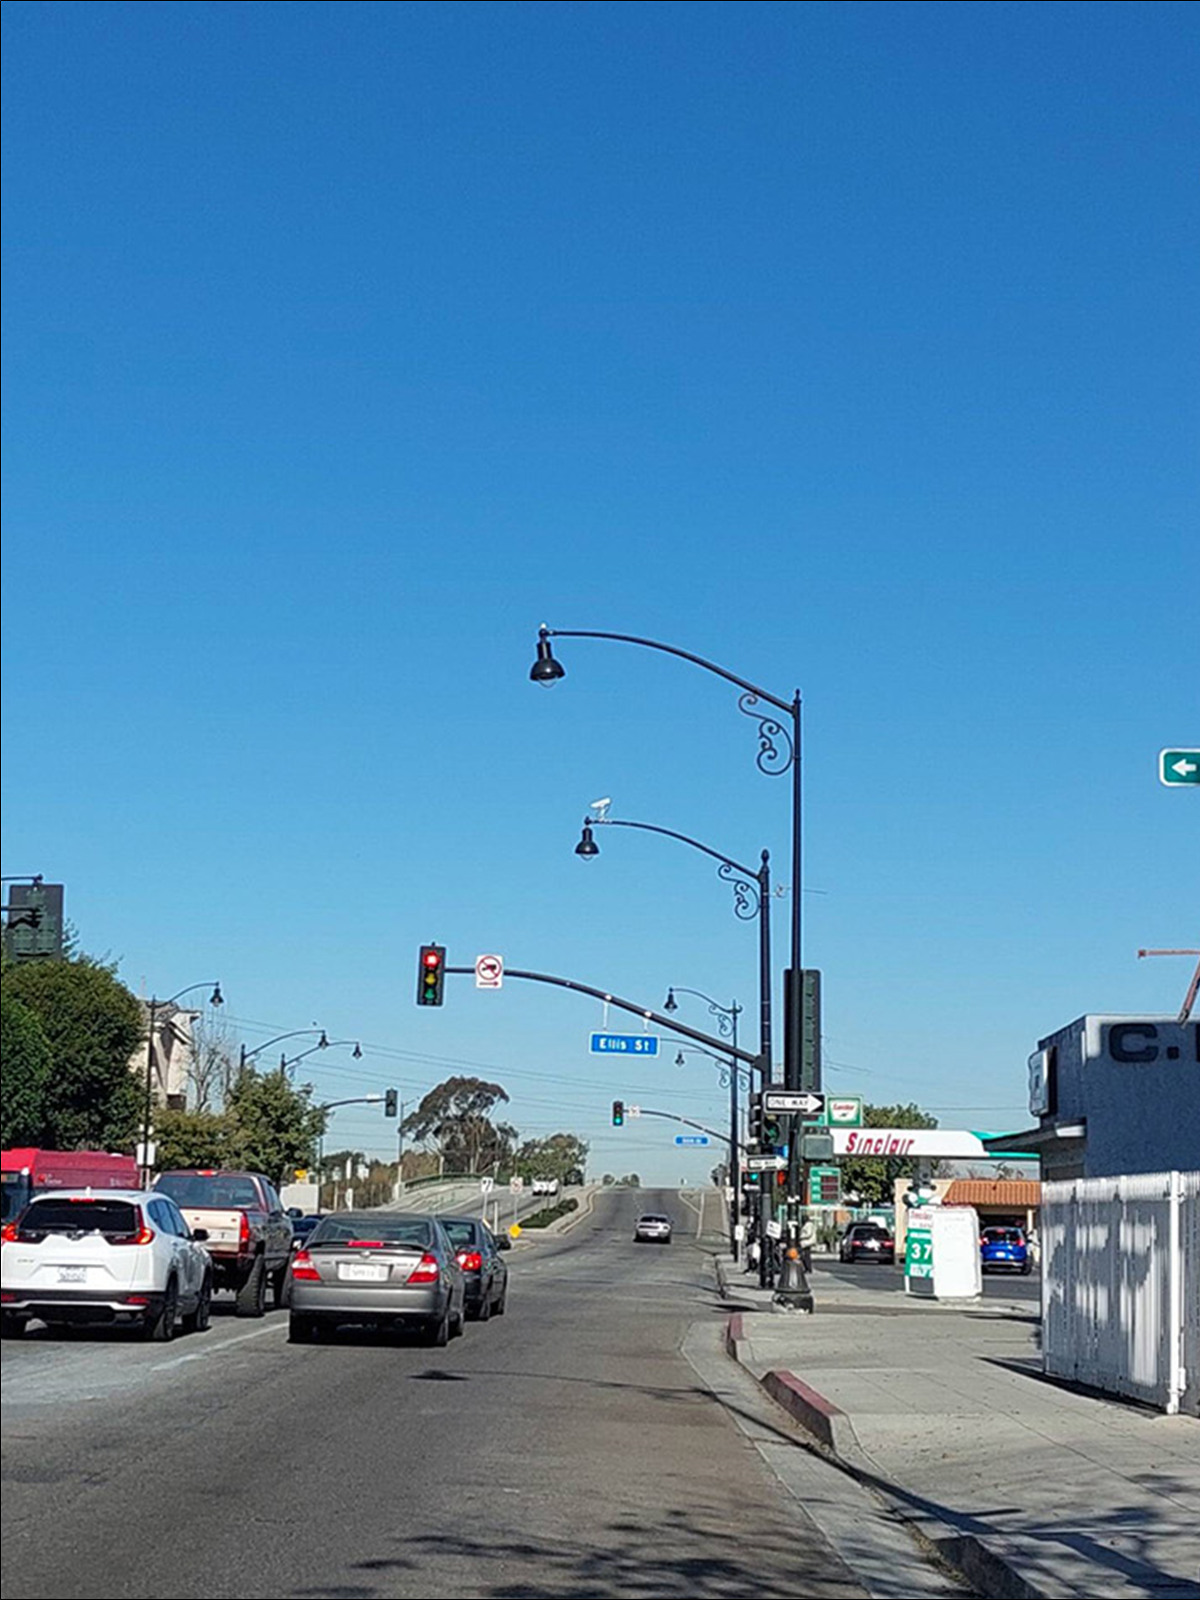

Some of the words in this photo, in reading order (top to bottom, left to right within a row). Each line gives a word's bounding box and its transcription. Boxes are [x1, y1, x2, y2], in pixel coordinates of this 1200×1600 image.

[599, 1038, 627, 1051] Ellis
[634, 1039, 650, 1052] St
[1108, 1022, 1181, 1063] C.
[845, 1131, 915, 1156] Sinclair
